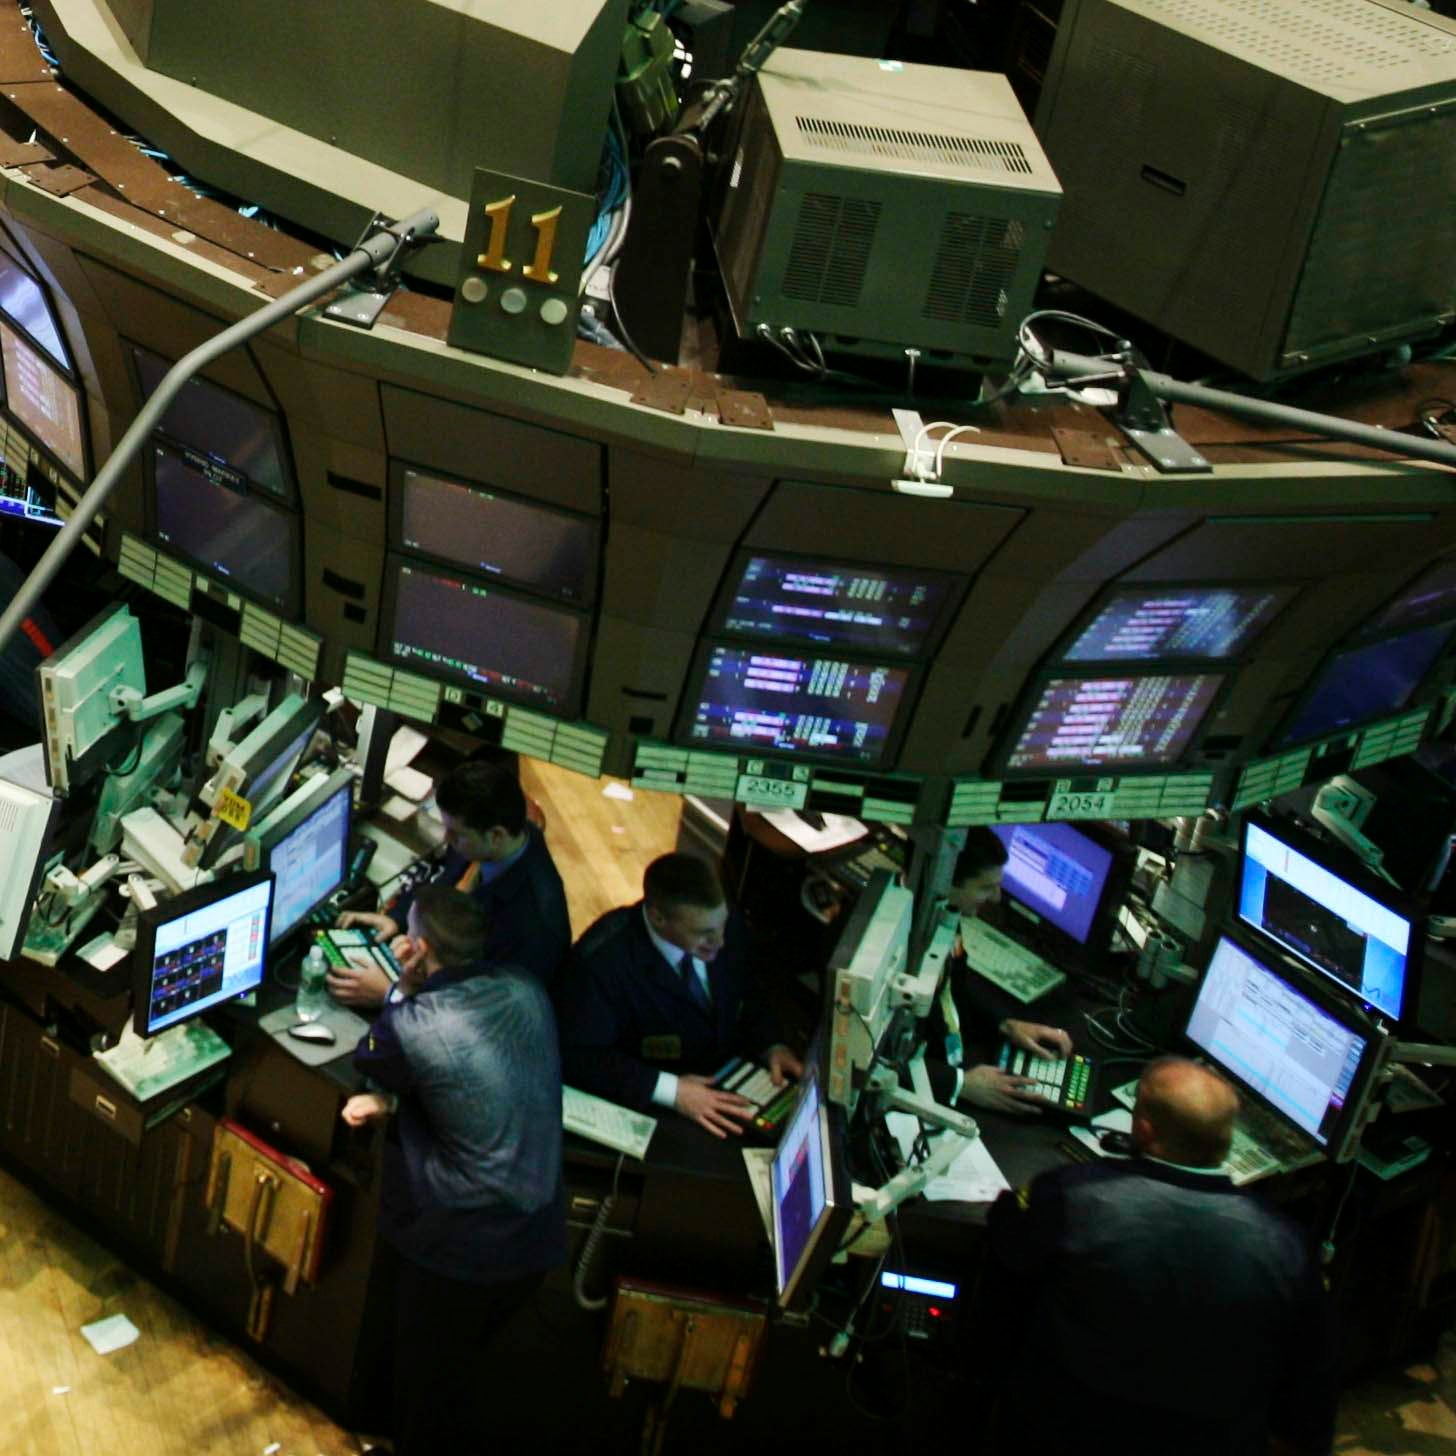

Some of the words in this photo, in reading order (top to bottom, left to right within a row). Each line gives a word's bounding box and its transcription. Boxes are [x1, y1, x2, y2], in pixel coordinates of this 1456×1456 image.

[477, 194, 562, 285] 11
[748, 778, 795, 797] 2355
[1057, 794, 1105, 812] 2054
